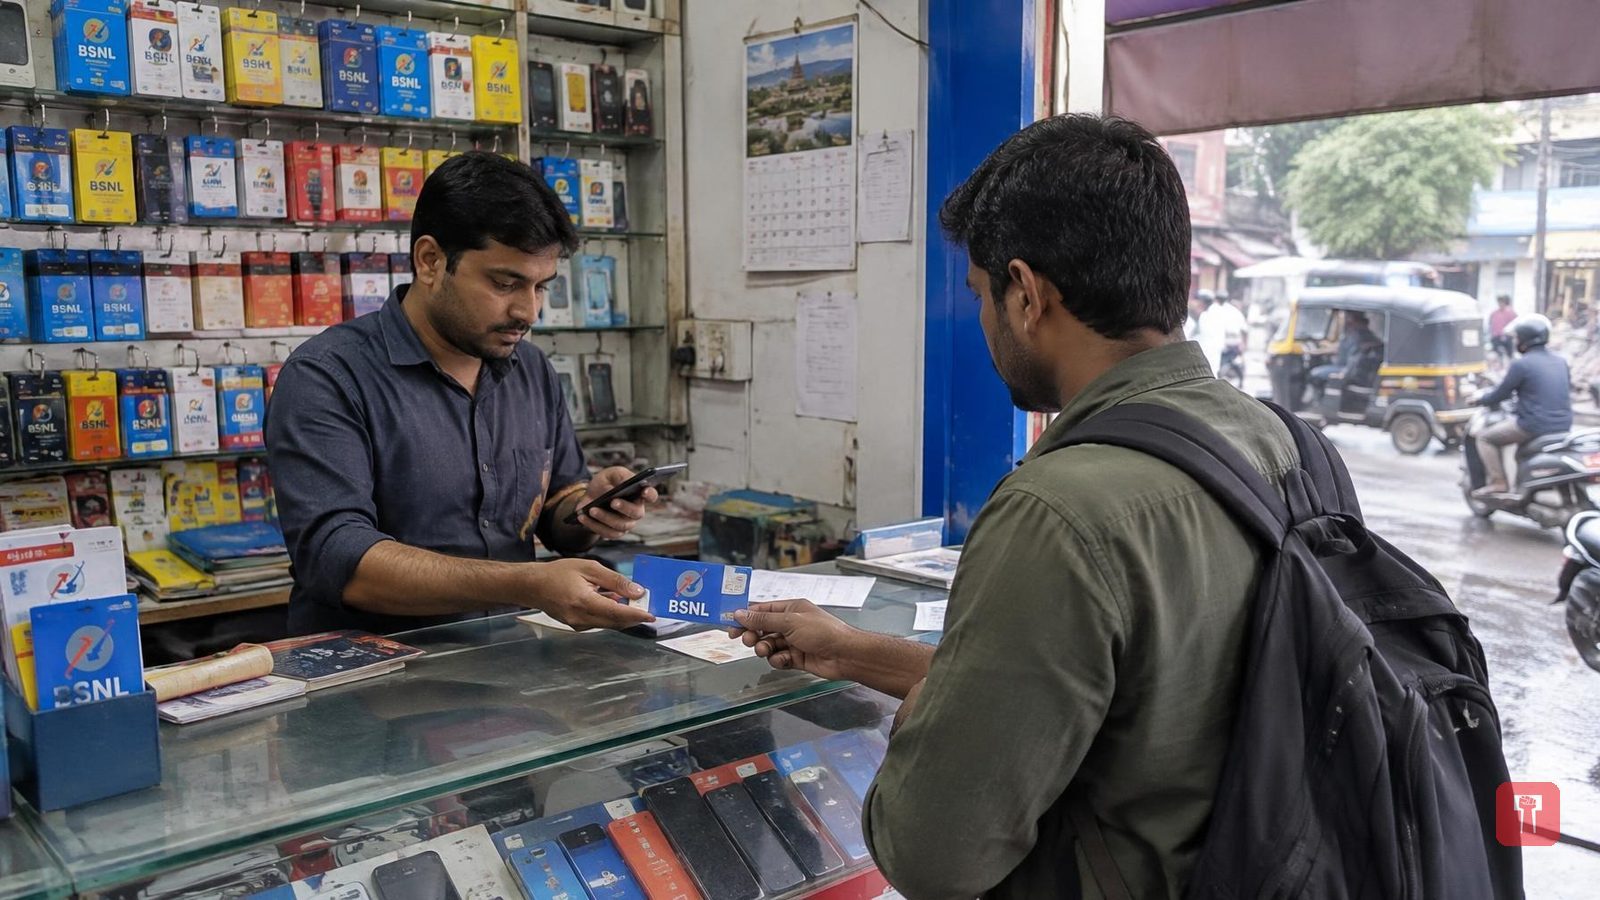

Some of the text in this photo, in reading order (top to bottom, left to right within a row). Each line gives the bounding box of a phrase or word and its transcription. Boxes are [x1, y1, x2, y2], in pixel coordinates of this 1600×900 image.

[78, 44, 116, 60] BSNL
[339, 69, 369, 84] BSNL
[391, 76, 421, 90] BSNL
[486, 82, 513, 95] BSNL
[90, 180, 124, 193] BSNL
[28, 423, 57, 435] BSNL
[668, 599, 709, 617] BSNL
[53, 676, 129, 708] BSNL
